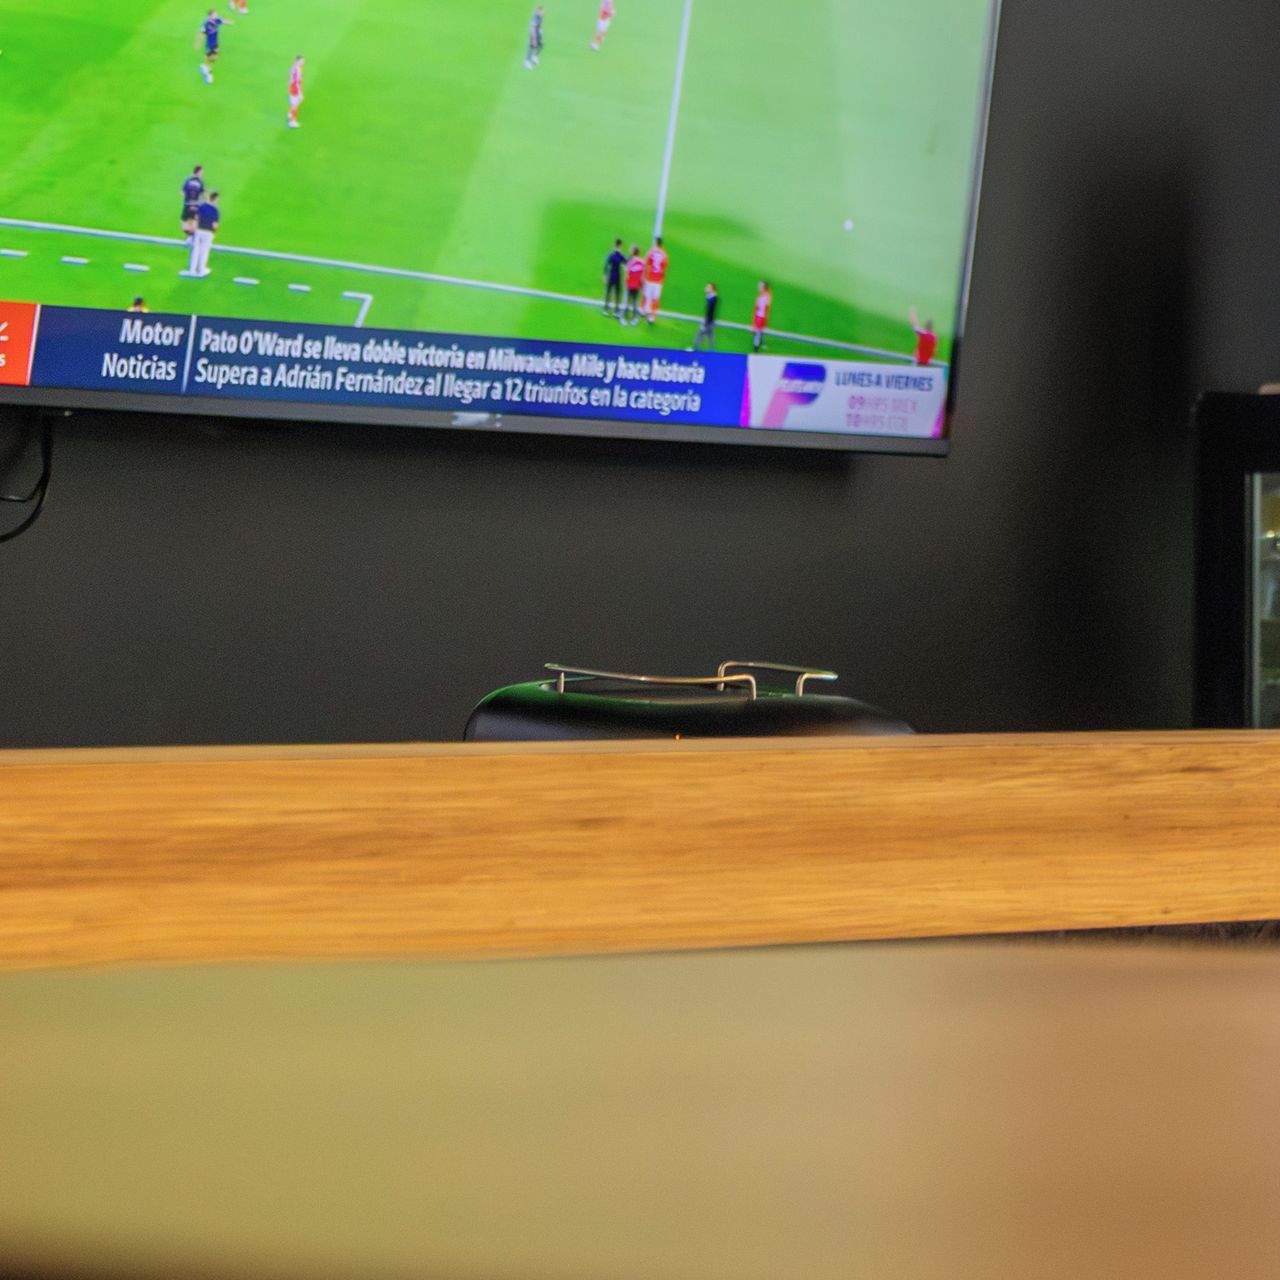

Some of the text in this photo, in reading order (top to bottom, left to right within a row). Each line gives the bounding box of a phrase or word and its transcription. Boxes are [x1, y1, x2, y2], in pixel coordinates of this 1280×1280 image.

[119, 318, 184, 347] Motor
[102, 352, 177, 382] Noticias
[200, 327, 238, 354] Pato
[239, 329, 304, 359] O'Ward
[303, 339, 323, 361] se
[323, 335, 361, 362] lleva
[362, 338, 407, 366] doble
[407, 341, 466, 370] victoria
[466, 350, 486, 371] en
[486, 345, 570, 376] Milwaukee
[603, 360, 617, 384] y
[616, 354, 651, 381] hace
[651, 357, 706, 385] historia
[194, 356, 259, 391] Supera
[259, 366, 273, 387] a
[273, 362, 333, 391] Adrián
[334, 365, 424, 397] Fernández
[424, 372, 443, 398] al
[443, 374, 491, 405] llegar
[490, 383, 503, 402] a
[504, 378, 525, 403] 12
[523, 377, 590, 407] triunfos
[590, 388, 612, 408] en
[612, 384, 628, 409] la
